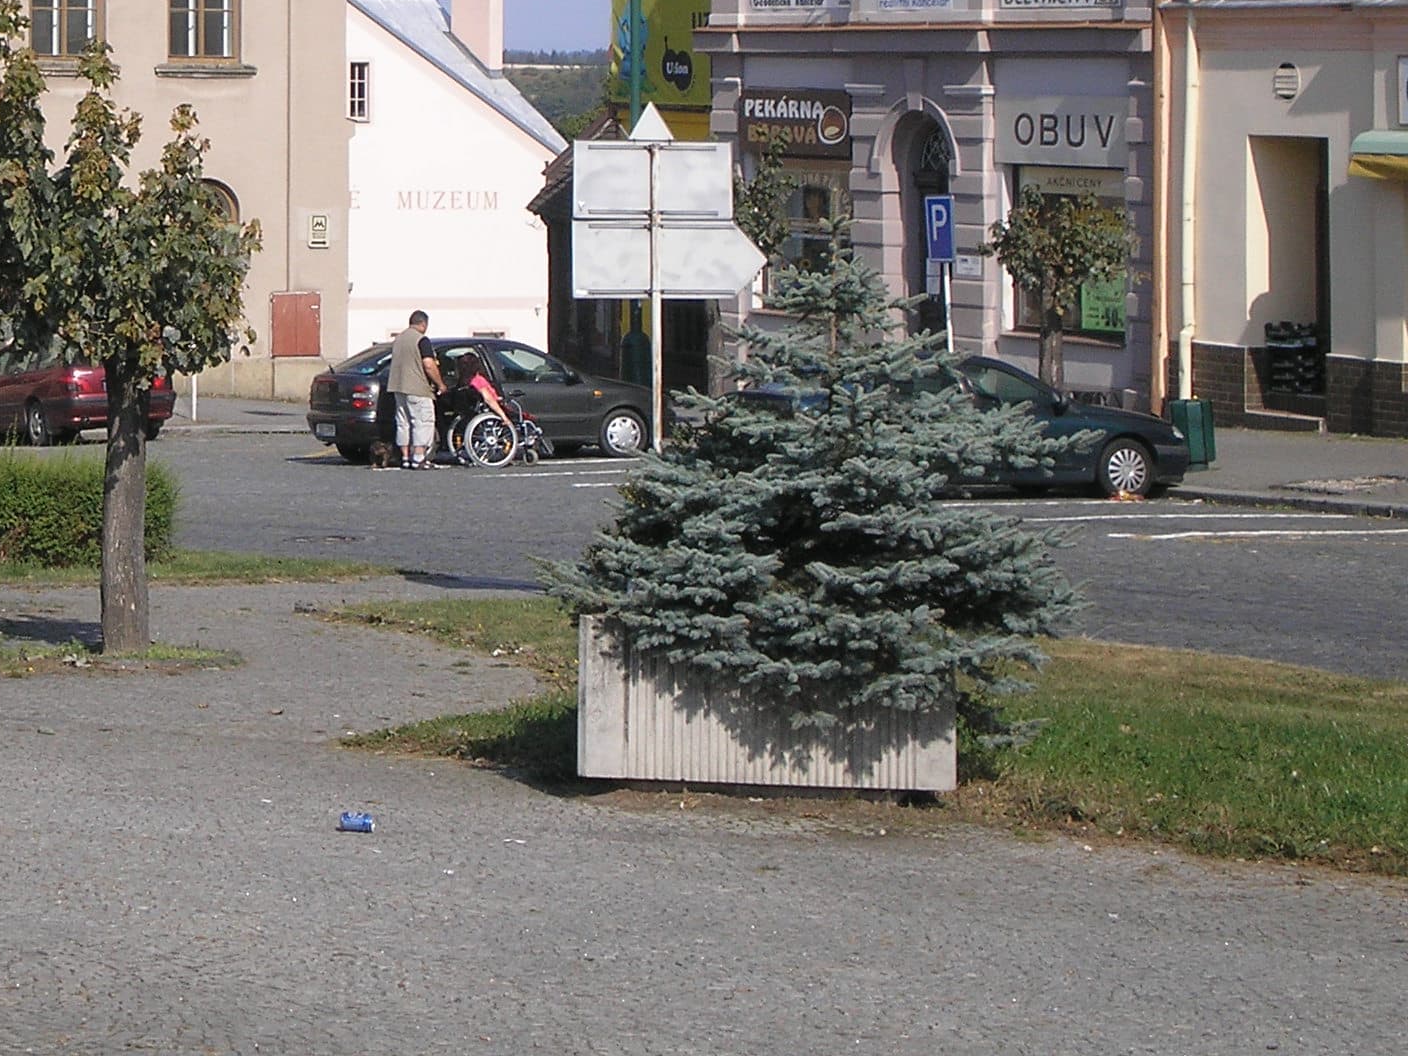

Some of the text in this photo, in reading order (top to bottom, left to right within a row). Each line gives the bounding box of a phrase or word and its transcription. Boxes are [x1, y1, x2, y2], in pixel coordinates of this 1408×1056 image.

[744, 95, 824, 119] PEKÁRNA
[1014, 112, 1115, 148] OBUV
[397, 191, 500, 210] MUZEUM
[931, 204, 947, 241] P
